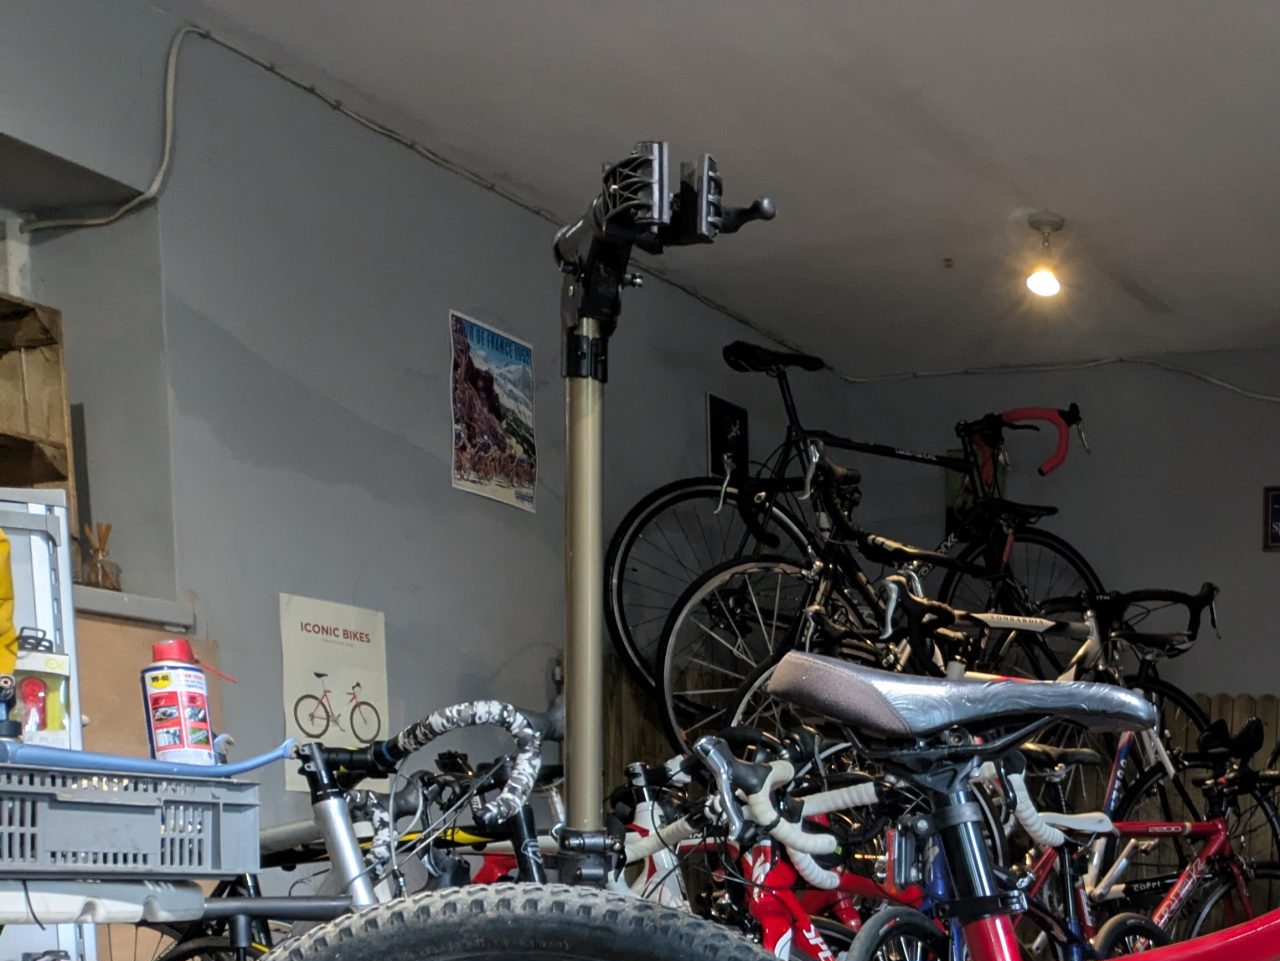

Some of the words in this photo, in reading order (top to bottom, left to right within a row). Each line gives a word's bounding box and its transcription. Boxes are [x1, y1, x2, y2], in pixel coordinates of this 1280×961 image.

[300, 621, 340, 638] ICONIC
[342, 629, 371, 644] BIKES
[1133, 881, 1162, 893] COPPI
